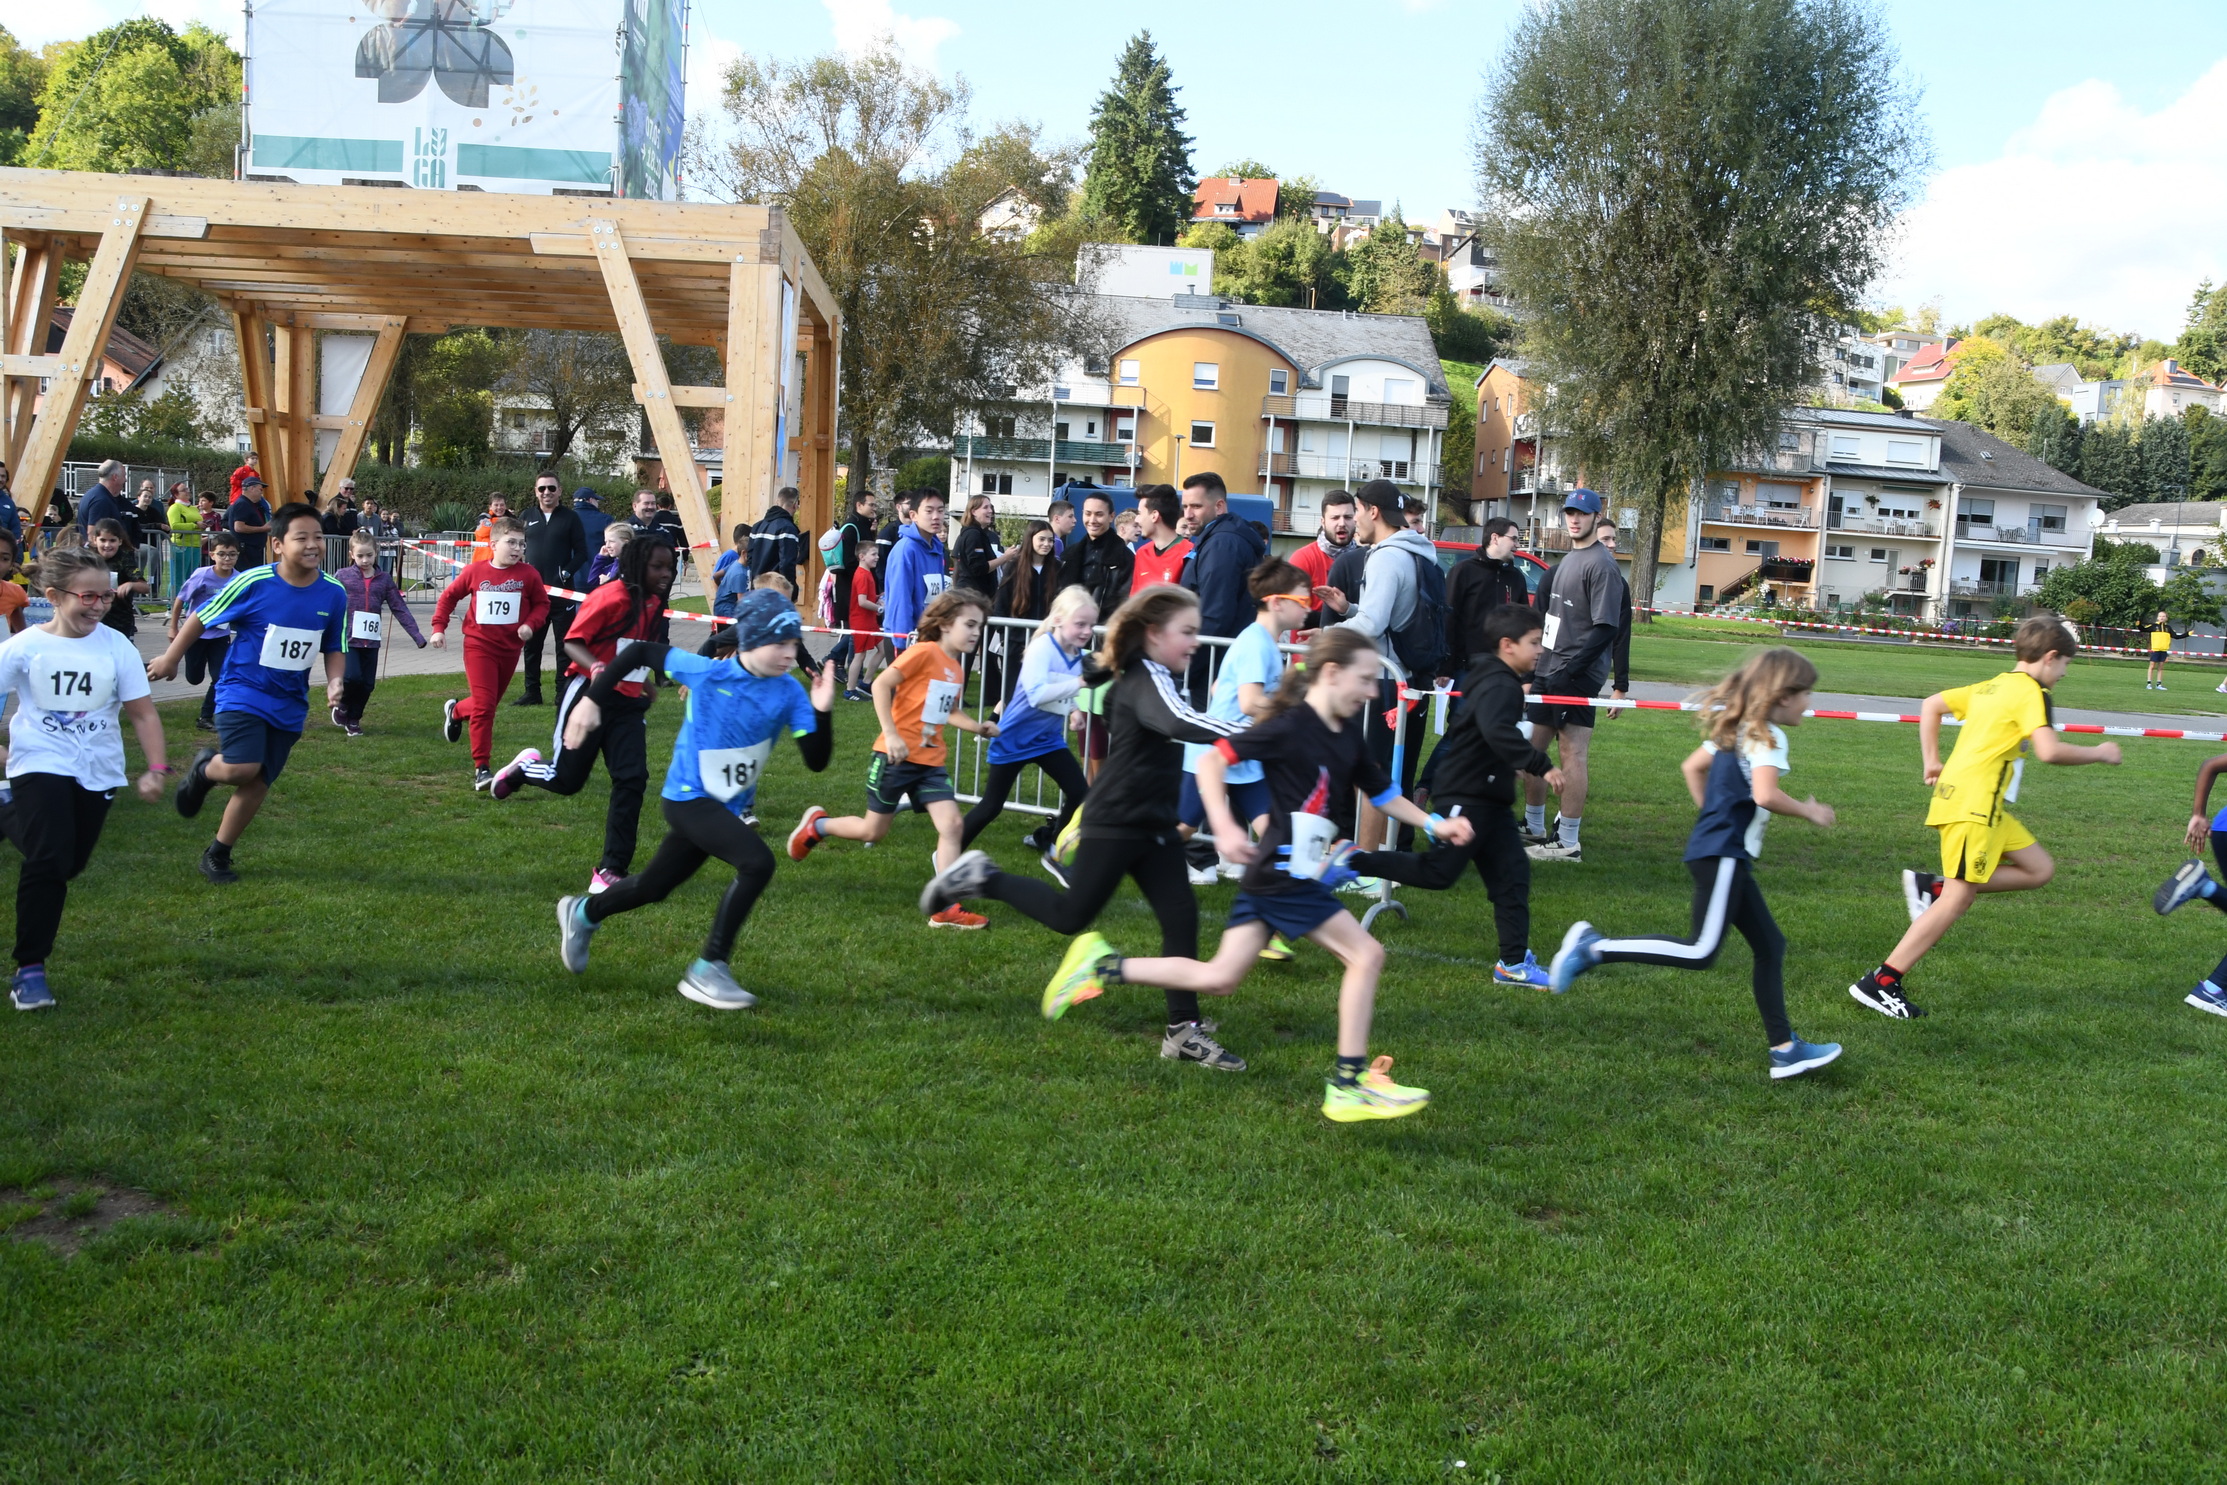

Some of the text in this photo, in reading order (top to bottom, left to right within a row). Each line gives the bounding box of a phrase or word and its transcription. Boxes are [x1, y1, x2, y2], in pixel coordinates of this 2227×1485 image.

[487, 600, 511, 616] 179
[362, 619, 380, 633] 168
[280, 639, 313, 660] 187
[50, 670, 93, 696] 174
